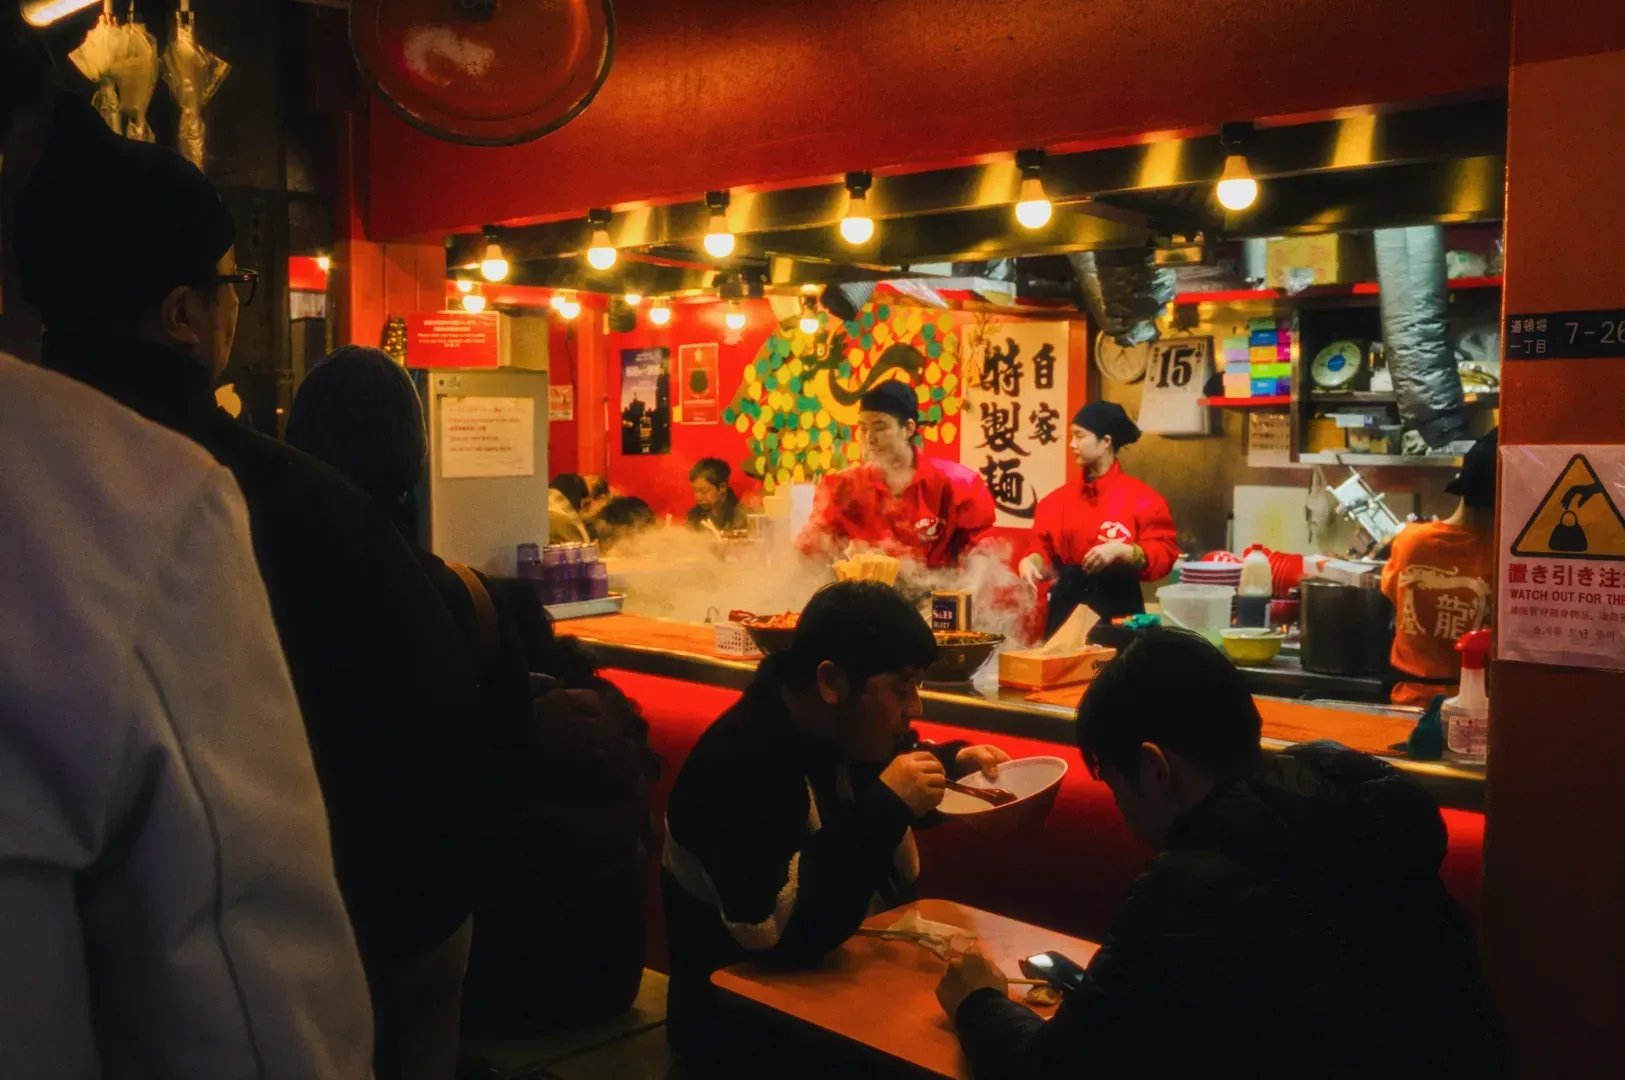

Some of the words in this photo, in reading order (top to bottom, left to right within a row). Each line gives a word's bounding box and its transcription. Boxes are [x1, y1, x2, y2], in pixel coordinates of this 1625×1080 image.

[1511, 318, 1548, 334] 道頓堀
[1510, 339, 1547, 354] 一丁目
[1156, 347, 1196, 389] 15
[1029, 343, 1060, 446] 自家
[1508, 563, 1625, 589] 置き引き注
[1510, 588, 1548, 601] WATCH
[1552, 590, 1575, 602] OUT
[1578, 592, 1602, 605] FOR
